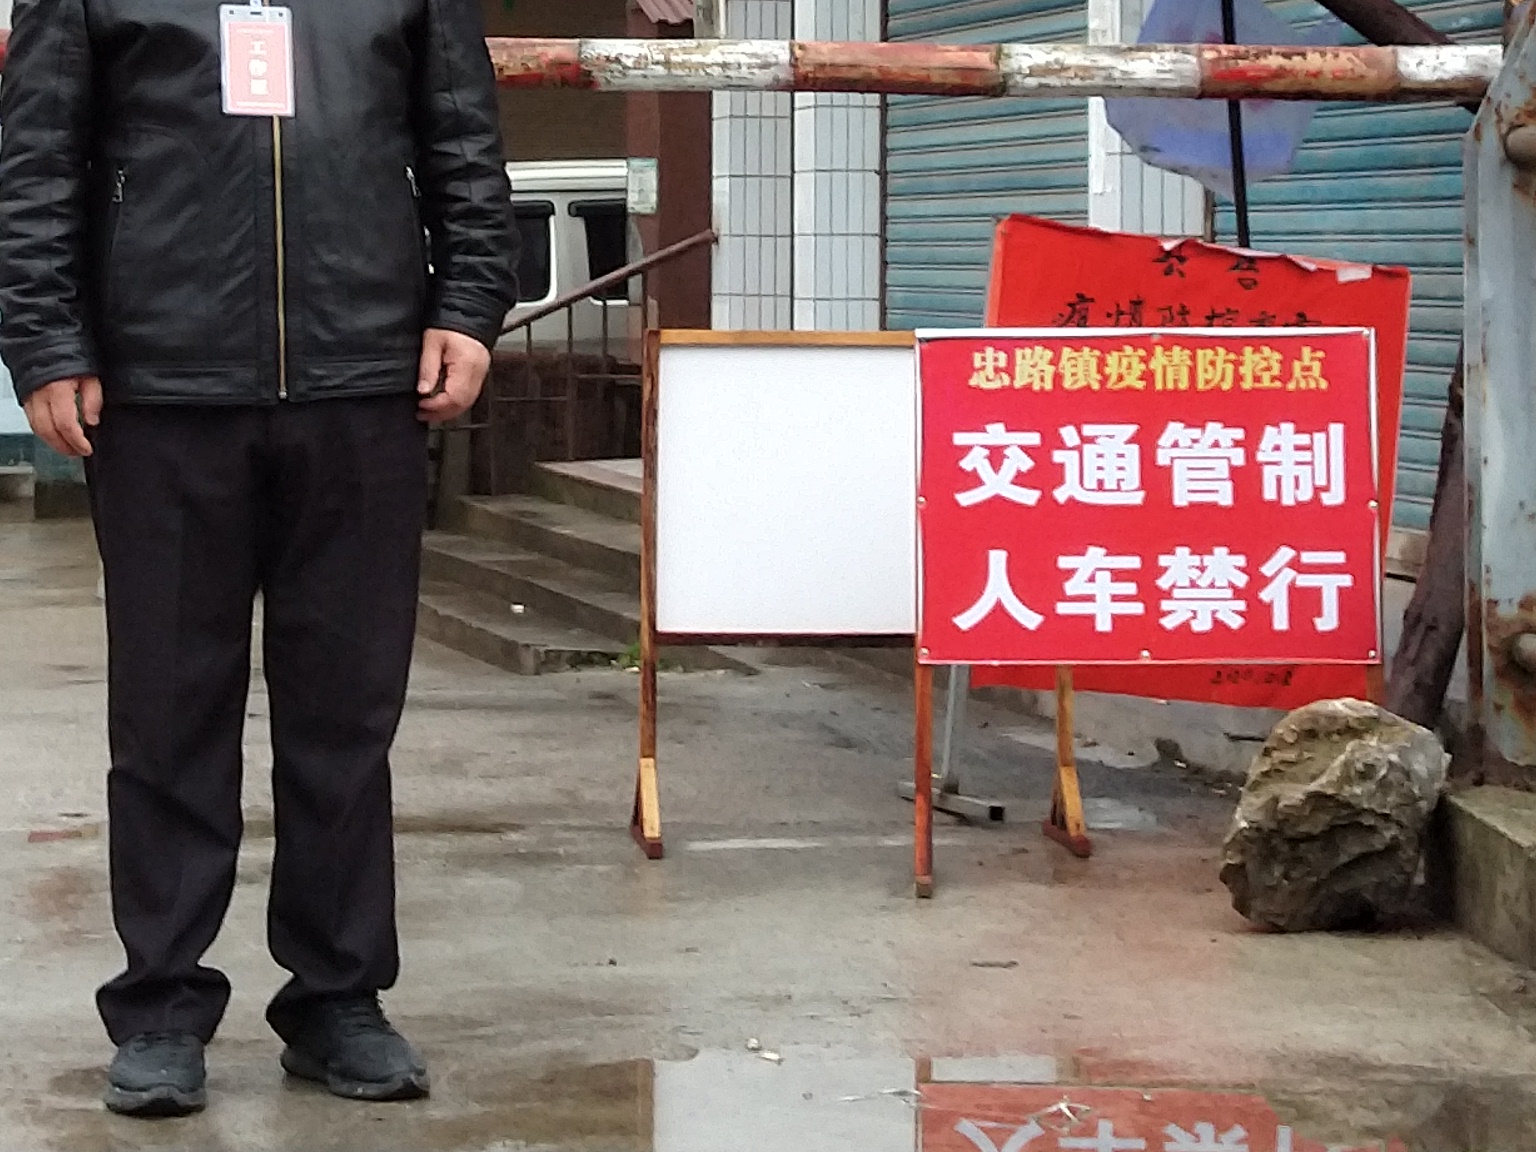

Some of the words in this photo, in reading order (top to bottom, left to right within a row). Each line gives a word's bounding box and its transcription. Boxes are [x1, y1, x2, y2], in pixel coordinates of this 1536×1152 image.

[967, 345, 1329, 392] 忠路镇疫情防控点
[952, 421, 1346, 507] 交通管制
[952, 546, 1354, 632] 人车禁行
